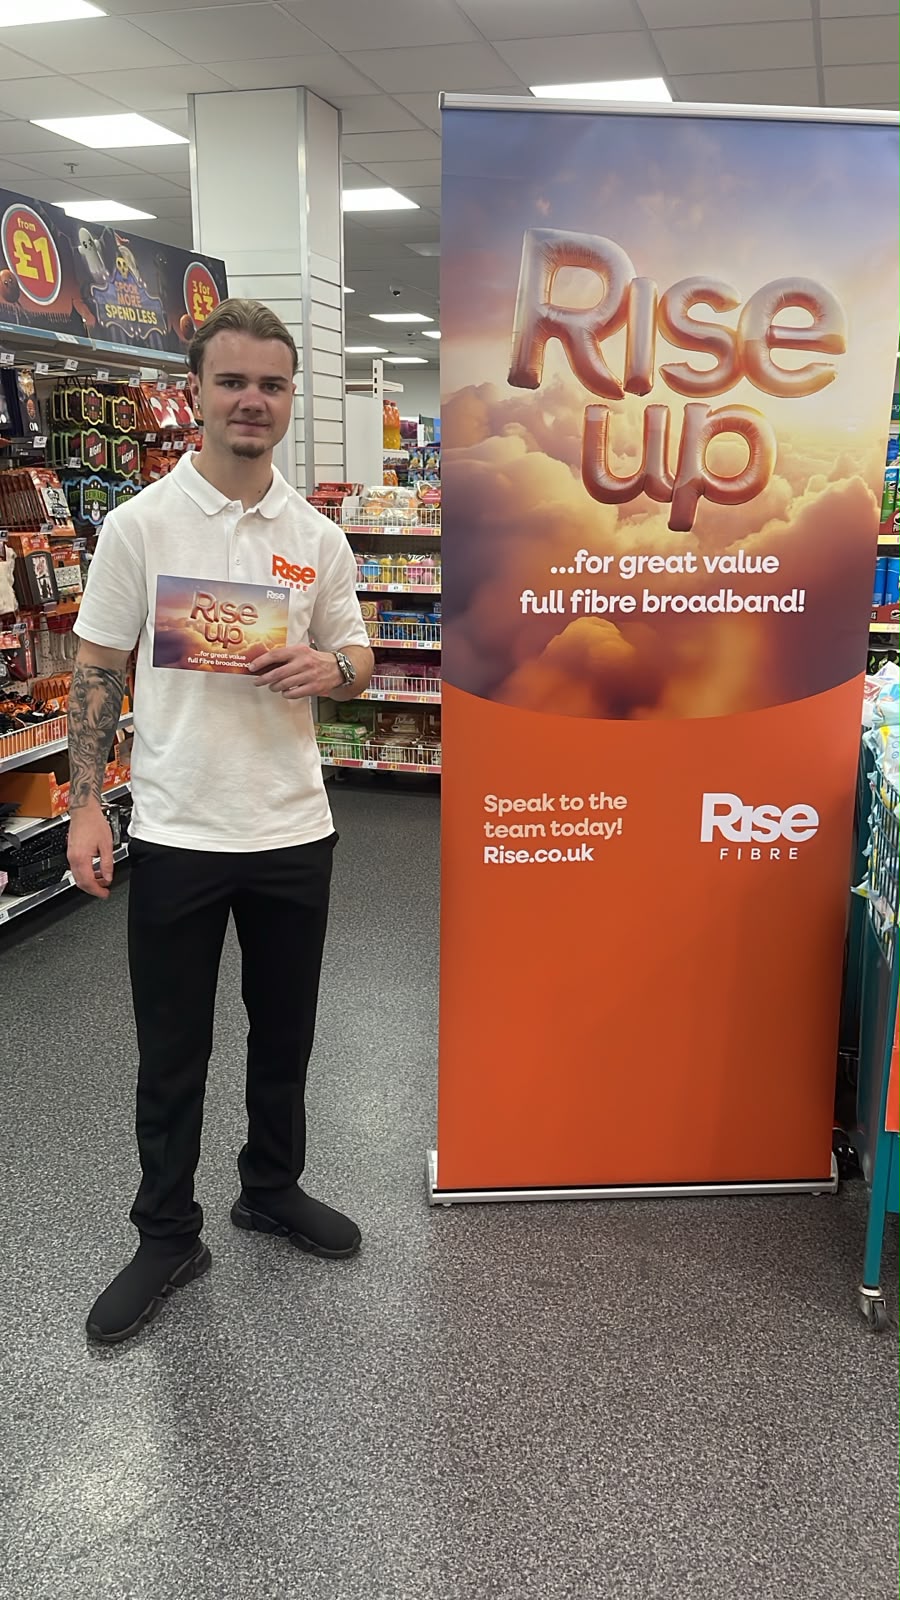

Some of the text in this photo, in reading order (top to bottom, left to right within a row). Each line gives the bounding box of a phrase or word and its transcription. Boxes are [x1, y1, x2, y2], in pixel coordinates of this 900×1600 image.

[17, 217, 36, 232] from
[13, 229, 54, 283] £1
[192, 280, 210, 295] 3 for
[117, 292, 142, 308] MORE
[105, 304, 157, 325] SPEND LESS
[507, 228, 846, 400] Rise
[581, 402, 777, 532] up
[272, 554, 316, 585] Rise
[619, 551, 697, 579] great
[703, 549, 780, 574] value
[266, 590, 286, 600] Rise
[520, 588, 806, 614] full fibre broadband!
[190, 590, 259, 626] Rise
[204, 622, 244, 649] up
[187, 656, 199, 664] full
[199, 658, 215, 666] fibre
[210, 652, 228, 660] great
[228, 653, 246, 661] value
[483, 791, 628, 817] Speak to the
[484, 817, 623, 840] team today!
[700, 792, 819, 843] Rise
[484, 843, 594, 864] Rise.co.uk
[719, 847, 799, 860] FIBRE
